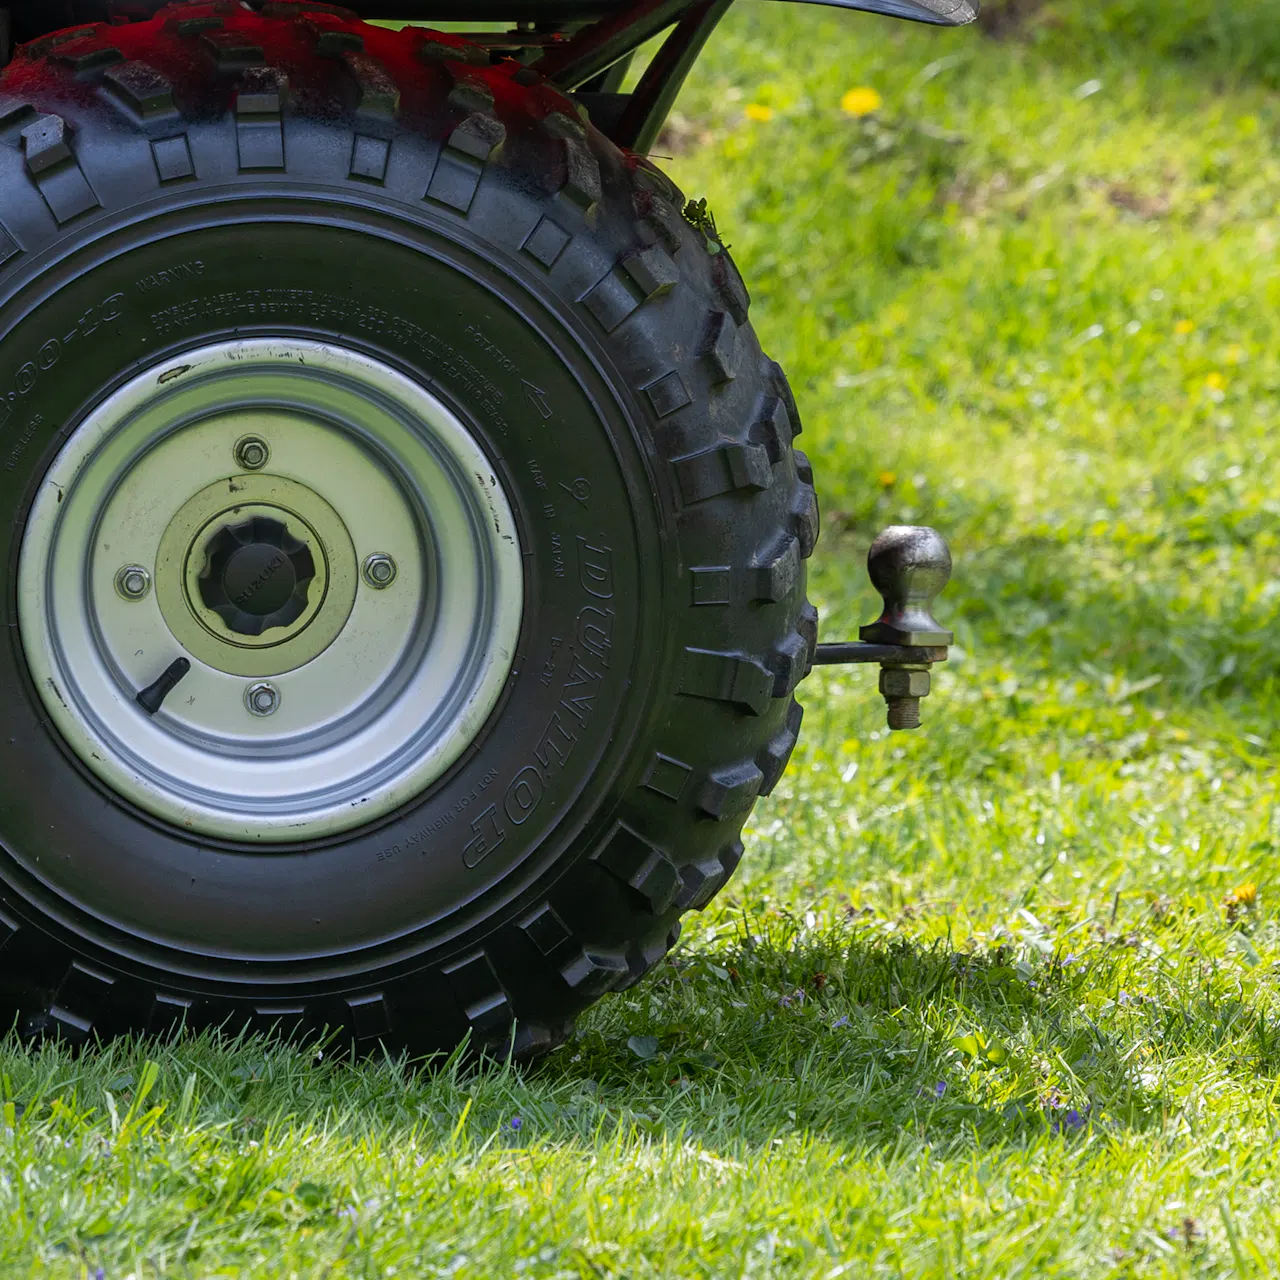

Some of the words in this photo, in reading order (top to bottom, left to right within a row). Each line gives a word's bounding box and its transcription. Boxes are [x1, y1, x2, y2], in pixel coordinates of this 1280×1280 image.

[135, 259, 206, 294] WARNING
[462, 322, 520, 377] ROTATION
[523, 456, 550, 494] MADE
[540, 501, 558, 521] IN
[547, 530, 567, 579] JAPAN
[234, 555, 284, 605] SUZUKI
[462, 530, 615, 870] DUNLOP
[474, 765, 500, 793] NOT
[451, 787, 480, 815] FOR
[402, 808, 456, 850] HIGHWAY
[373, 841, 402, 863] USE
